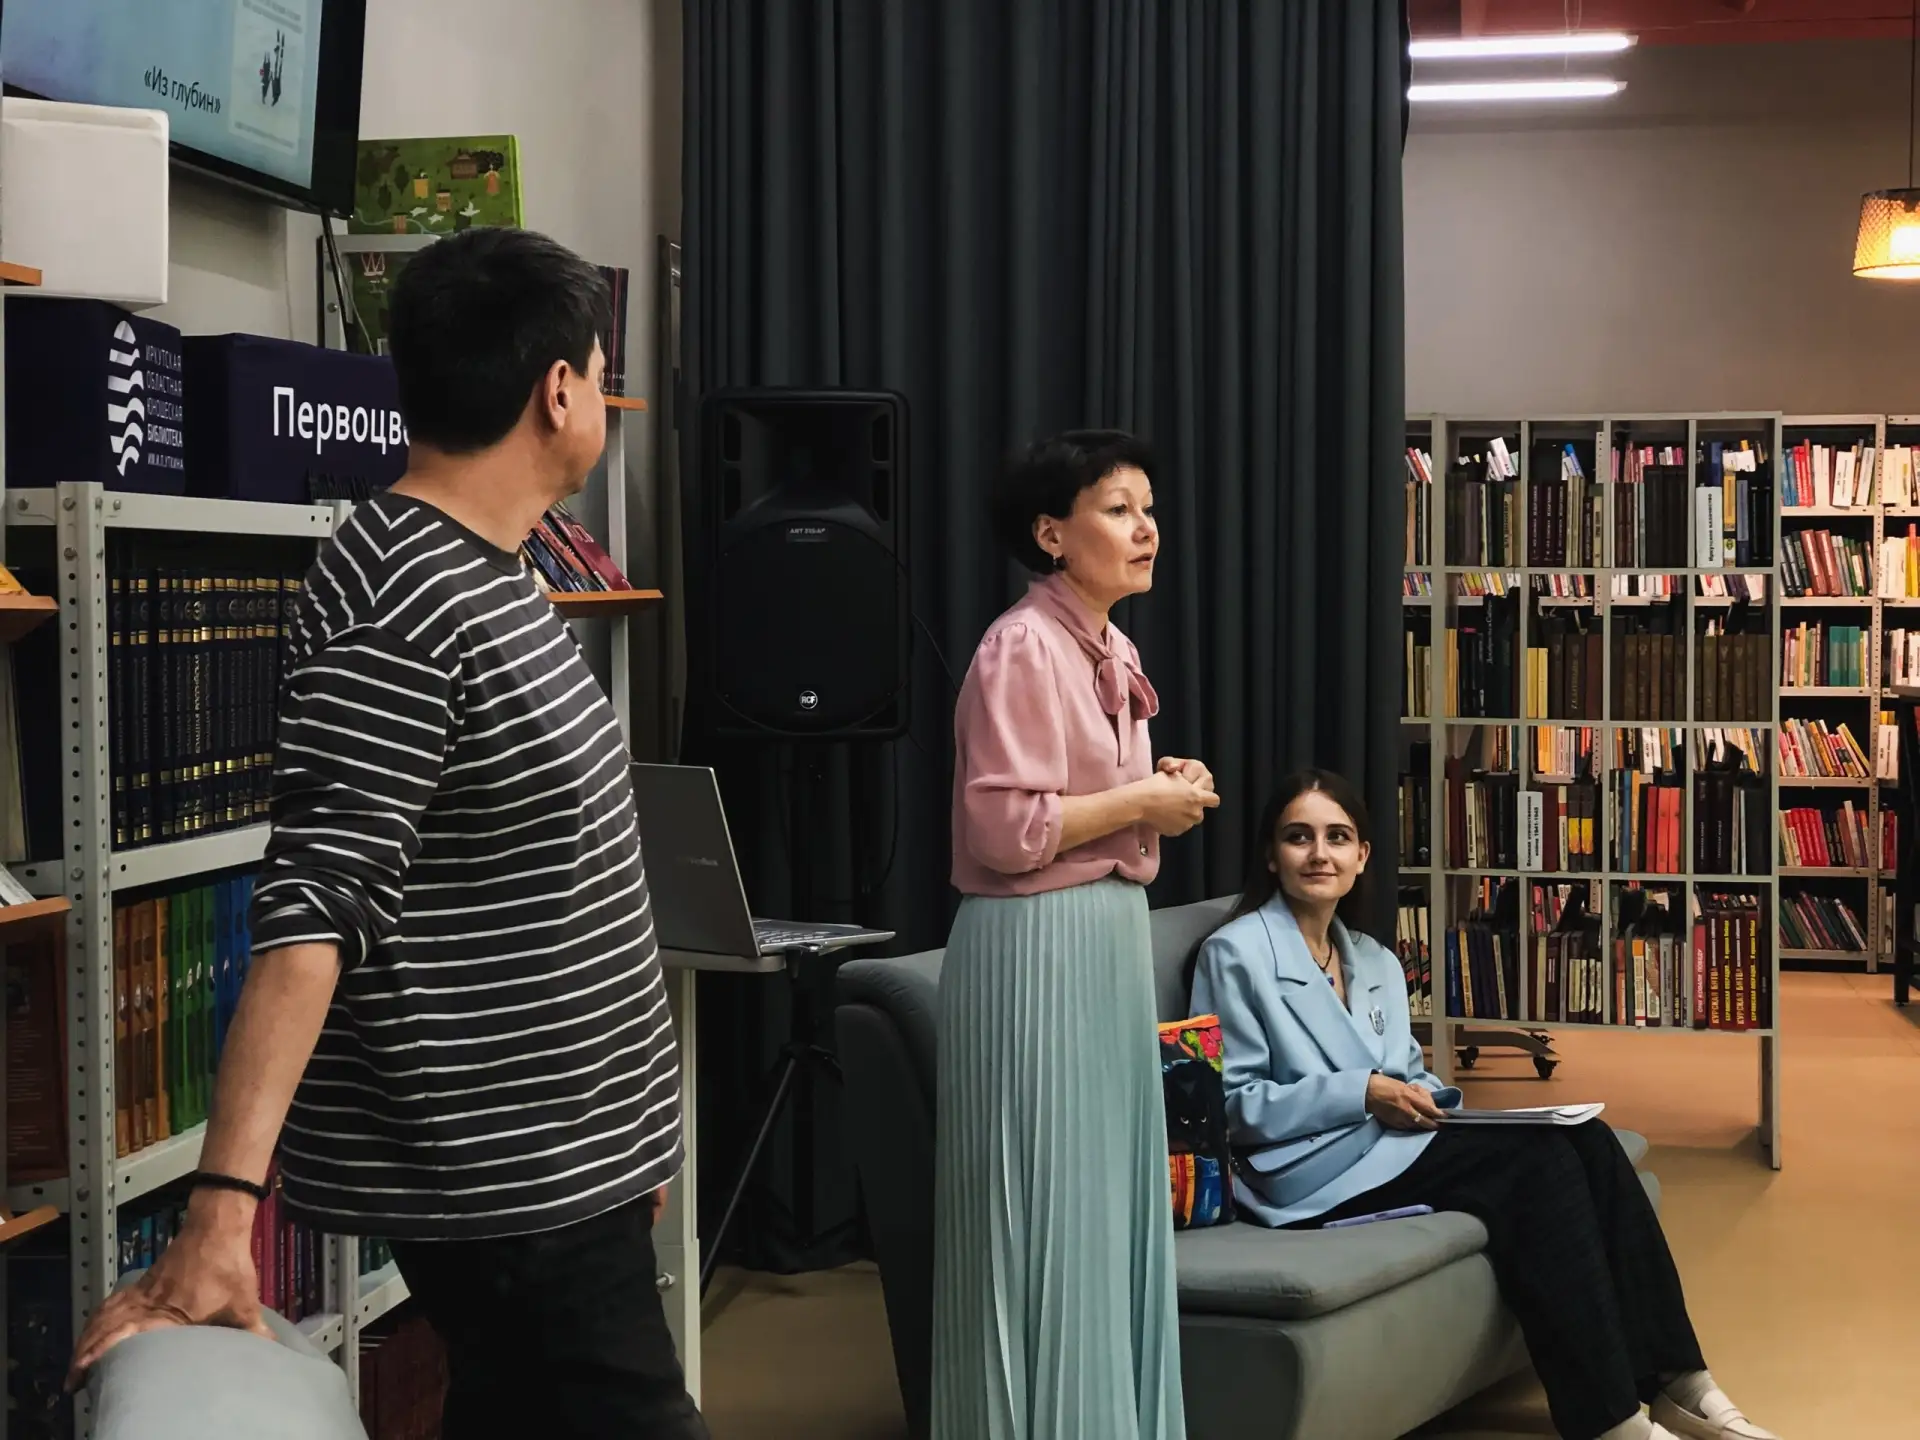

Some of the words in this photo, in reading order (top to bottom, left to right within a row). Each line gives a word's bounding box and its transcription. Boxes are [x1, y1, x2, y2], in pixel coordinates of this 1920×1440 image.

[144, 65, 168, 97] «Из
[171, 81, 221, 114] глубин»
[145, 344, 182, 372] ИРКУТСКАЯ
[146, 370, 183, 397] ОБЛАСТНАЯ
[147, 397, 183, 422] ЮНОШЕСКАЯ
[147, 423, 183, 448] БИБЛИОТЕКА
[801, 695, 816, 704] RCF
[1711, 991, 1720, 1024] КУРСКАЯ
[1736, 992, 1745, 1025] КУРСКАЯ
